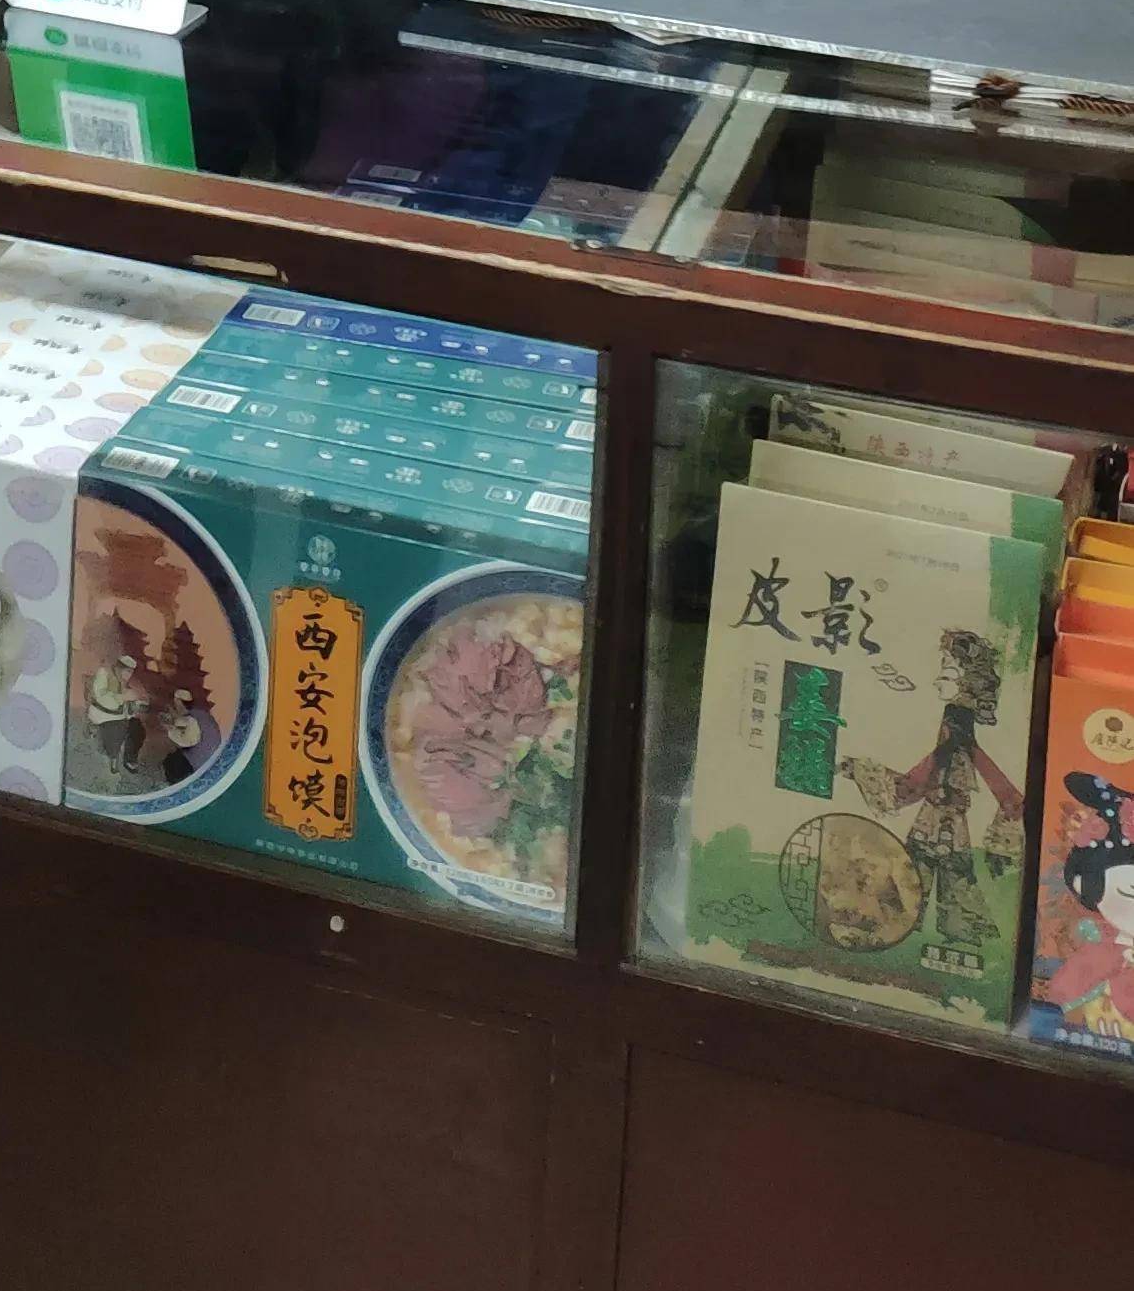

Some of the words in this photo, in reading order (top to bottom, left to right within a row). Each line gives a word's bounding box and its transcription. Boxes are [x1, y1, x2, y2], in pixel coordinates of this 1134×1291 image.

[729, 556, 882, 656] 皮影
[288, 613, 337, 817] 西安泡馍
